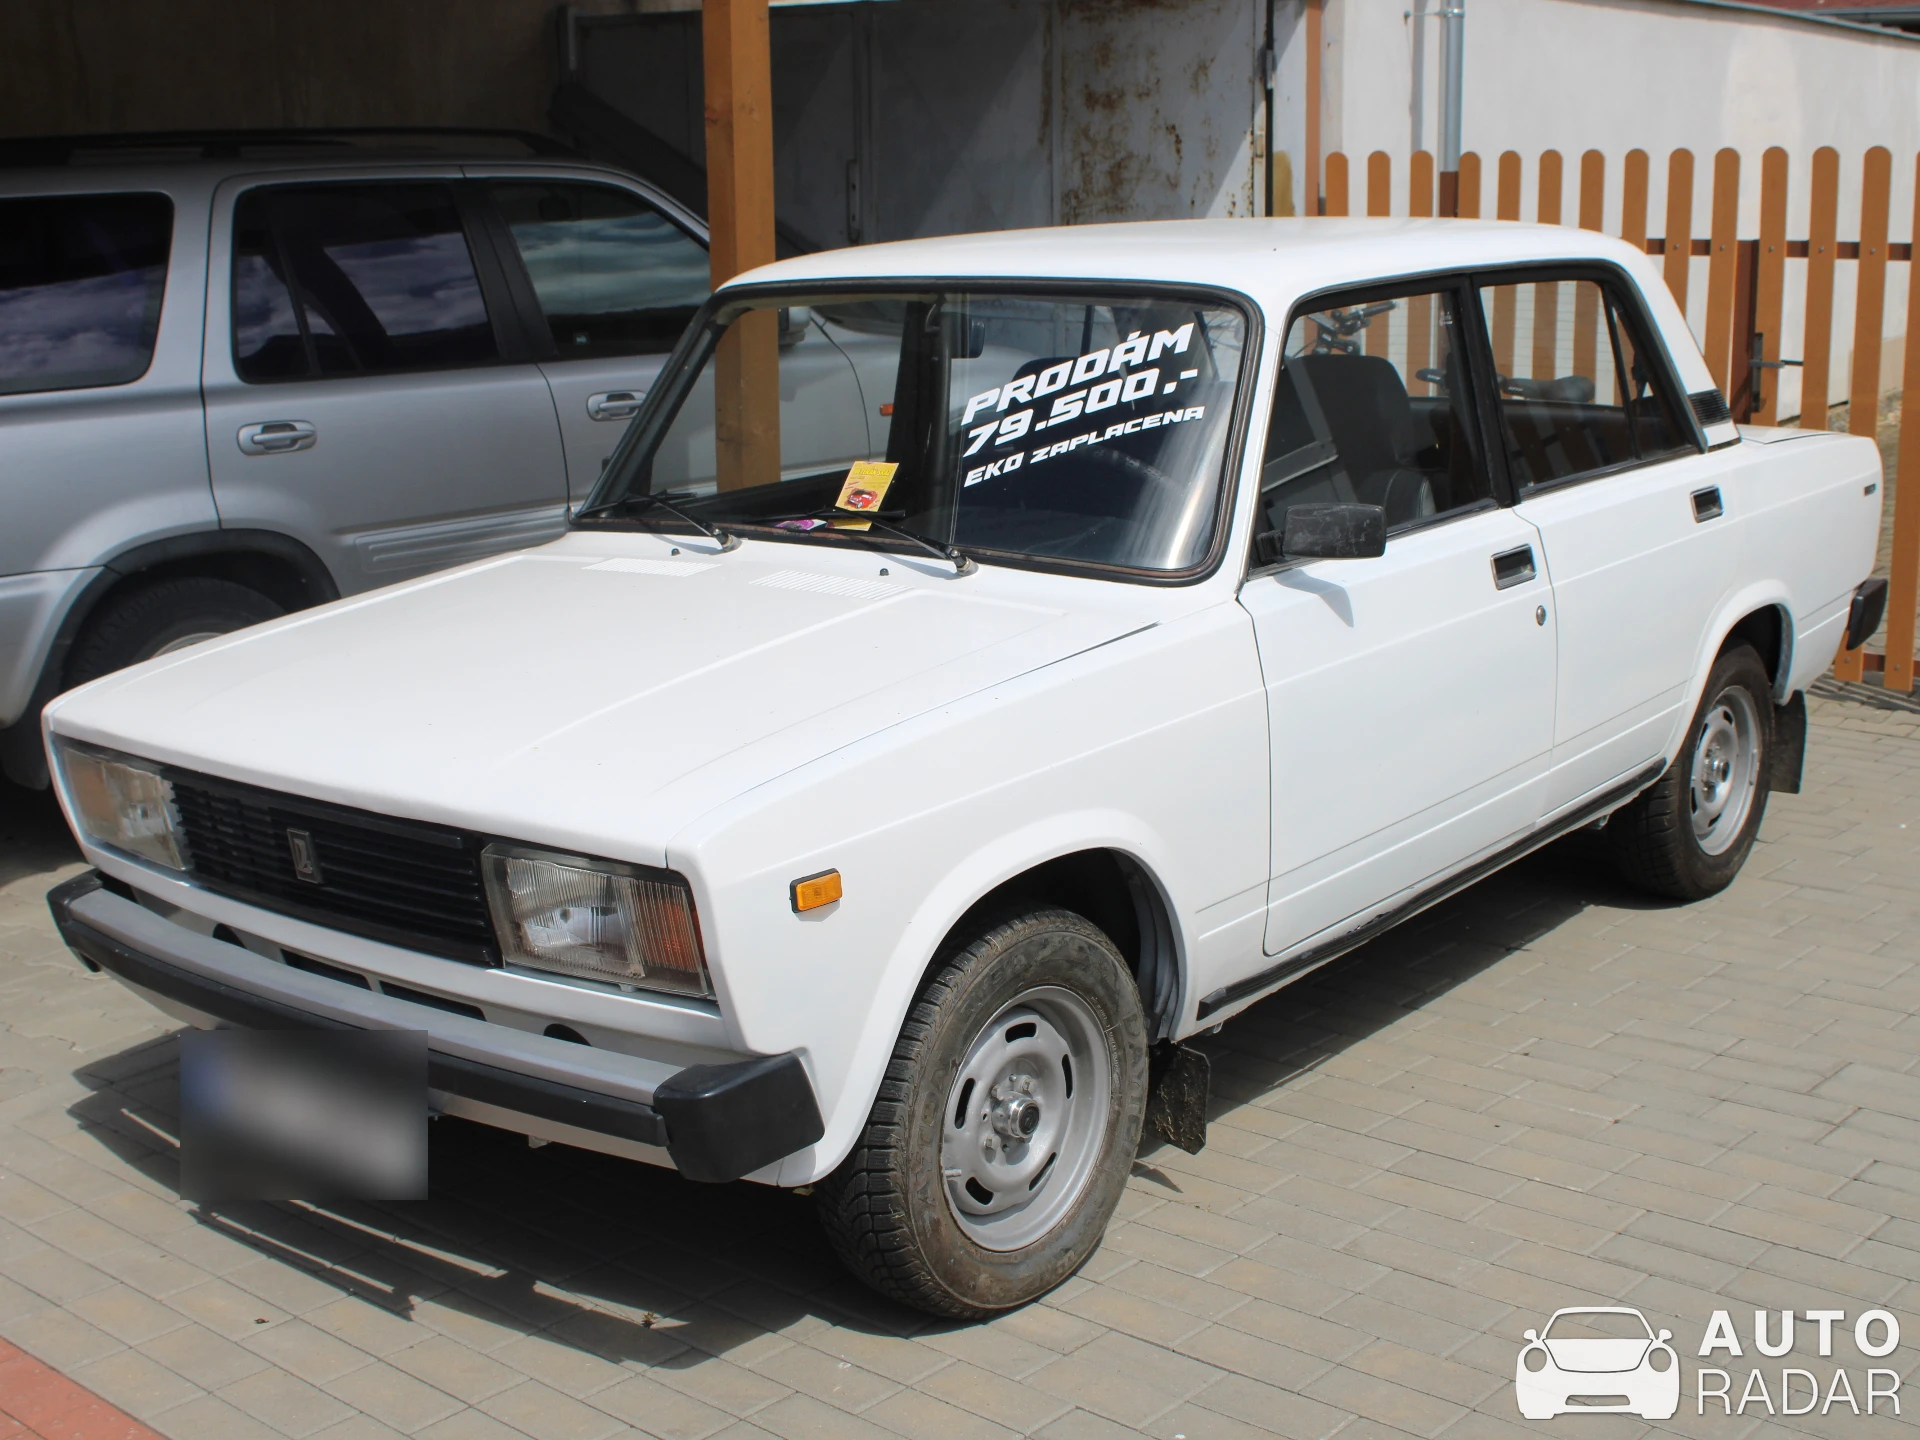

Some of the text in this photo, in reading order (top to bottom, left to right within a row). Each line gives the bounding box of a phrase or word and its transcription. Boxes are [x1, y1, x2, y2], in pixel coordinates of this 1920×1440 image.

[961, 322, 1195, 426] PRODÁM
[963, 368, 1198, 457] 79.500.-
[964, 406, 1205, 487] EKO ZAPLACENA
